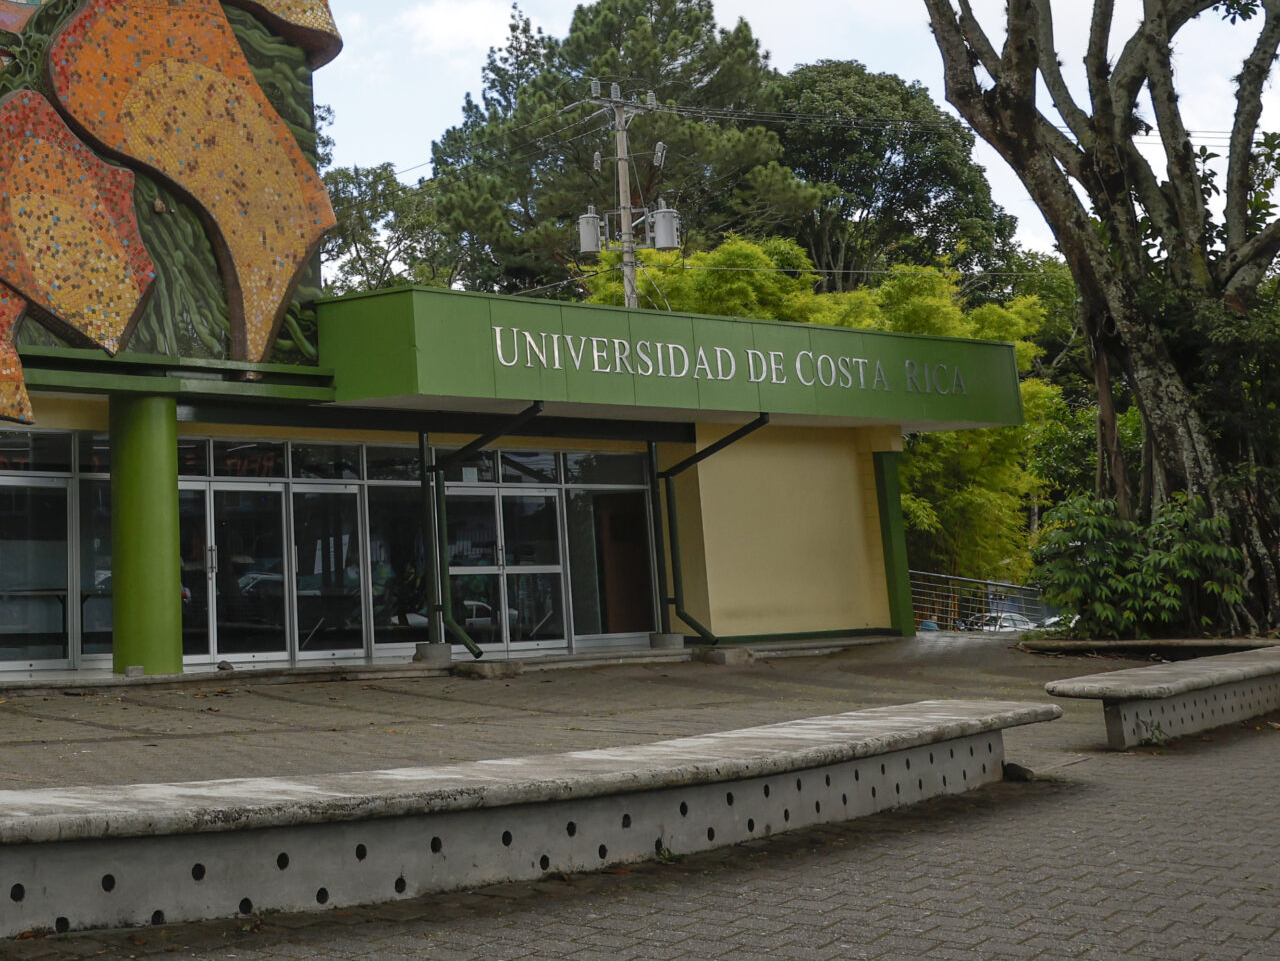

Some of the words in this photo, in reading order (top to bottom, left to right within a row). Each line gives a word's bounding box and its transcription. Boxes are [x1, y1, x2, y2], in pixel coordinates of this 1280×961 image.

[492, 326, 737, 381] UNIVERSIDAD
[745, 349, 787, 385] DE
[795, 350, 890, 392] COSTA
[904, 358, 968, 395] RICA
